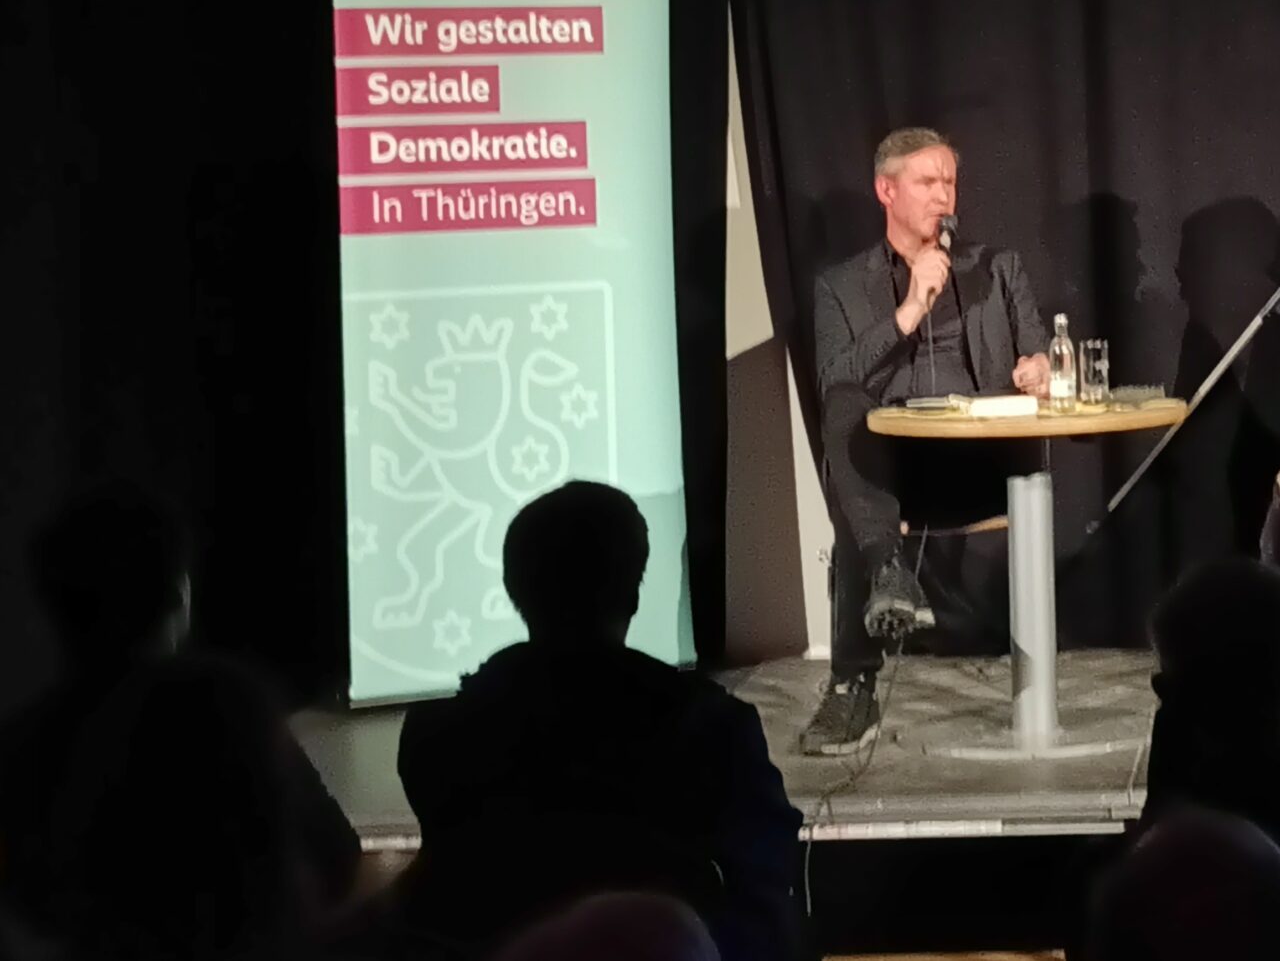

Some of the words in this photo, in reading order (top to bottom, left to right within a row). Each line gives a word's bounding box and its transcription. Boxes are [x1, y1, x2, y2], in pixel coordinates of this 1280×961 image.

[364, 13, 428, 46] Wir
[437, 11, 595, 53] gestalten
[367, 70, 491, 106] Soziale
[369, 126, 578, 164] Demokratie.
[372, 190, 403, 223] In
[412, 186, 586, 226] Thüringen.
